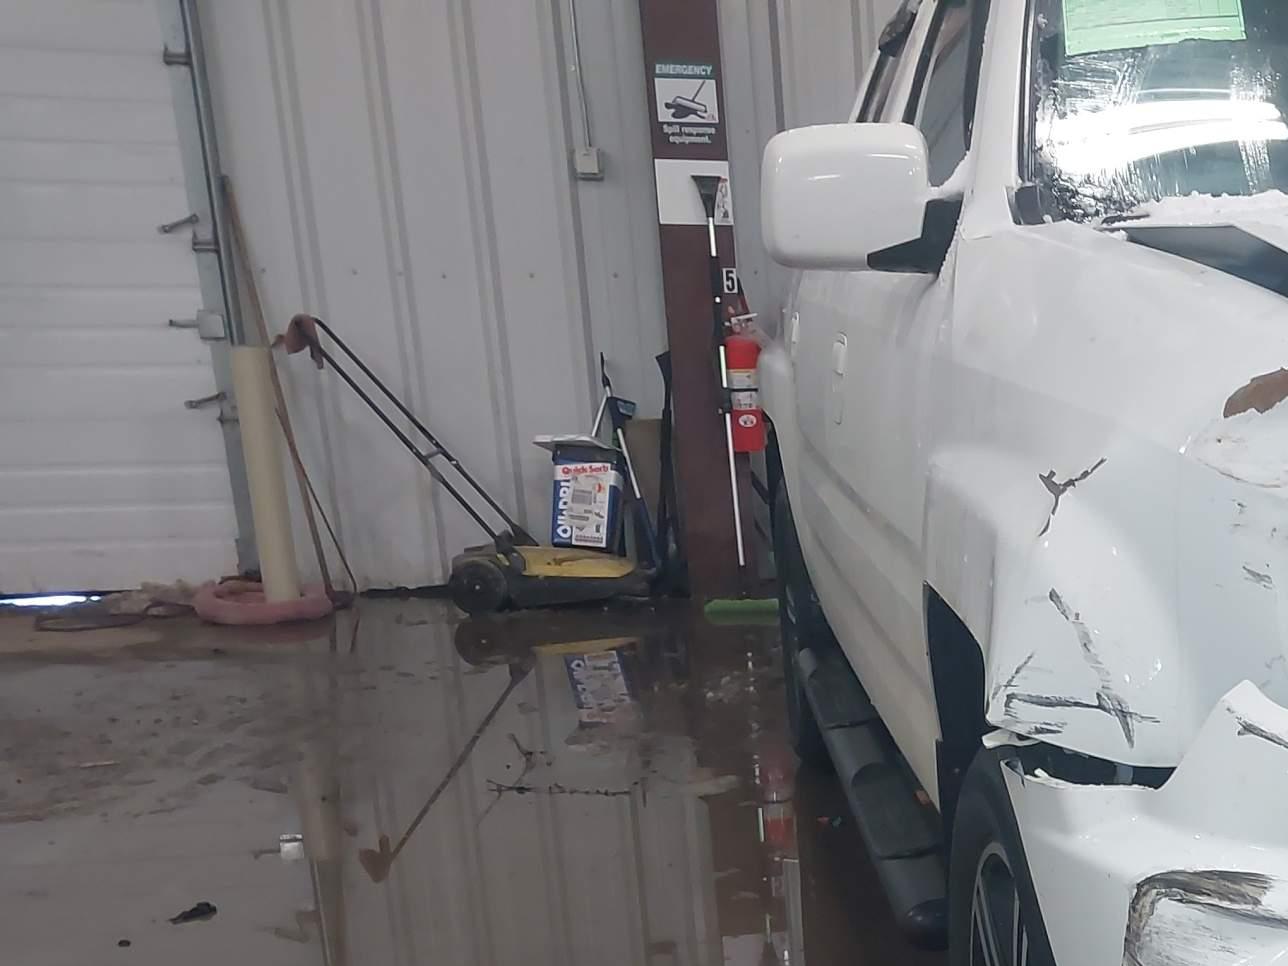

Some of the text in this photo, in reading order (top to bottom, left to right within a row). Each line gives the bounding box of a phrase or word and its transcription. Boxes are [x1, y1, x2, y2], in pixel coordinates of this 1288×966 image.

[655, 64, 713, 75] EMERGENCY
[663, 124, 716, 136] Spill response
[725, 269, 736, 292] 5
